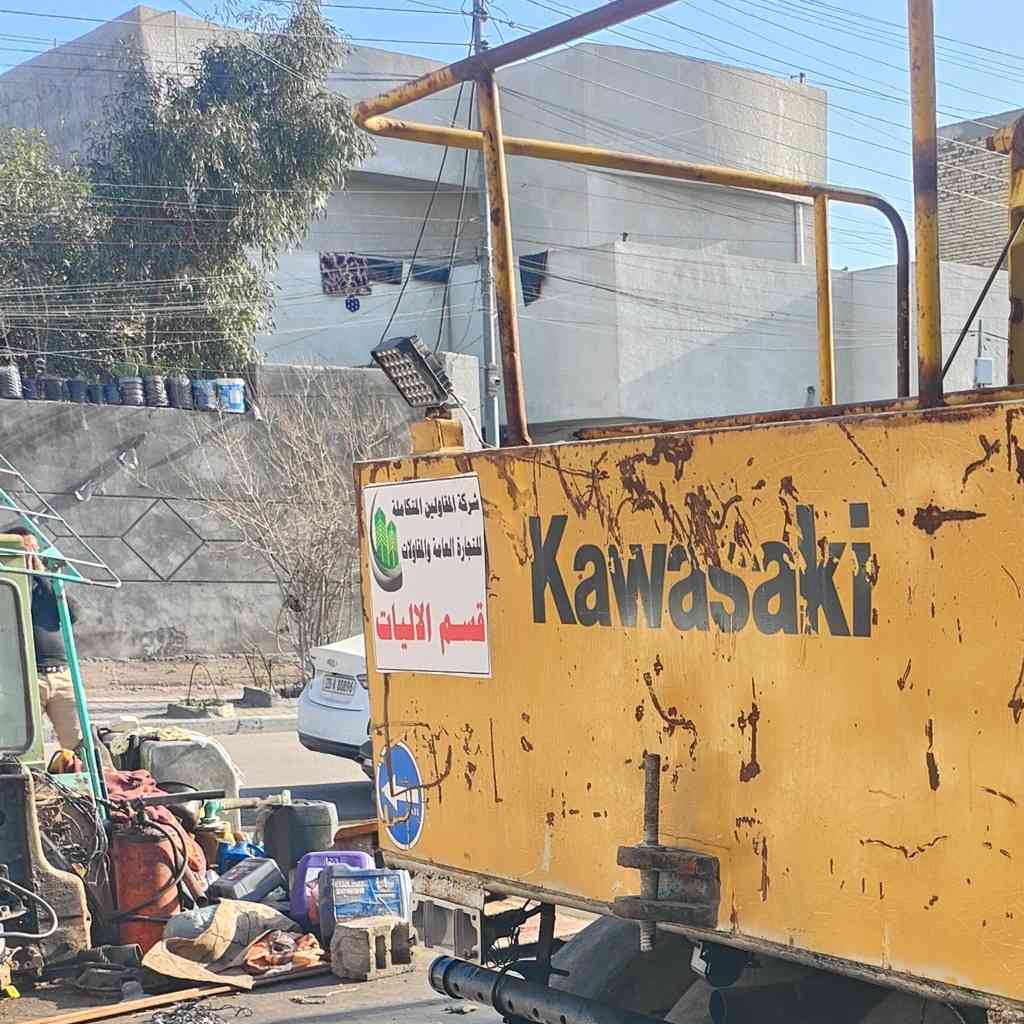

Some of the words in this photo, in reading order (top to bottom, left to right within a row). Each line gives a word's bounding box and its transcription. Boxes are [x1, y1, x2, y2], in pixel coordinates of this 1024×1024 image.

[424, 495, 457, 520] المقاولين
[458, 491, 481, 516] شركة
[432, 536, 455, 560] العامة
[457, 535, 482, 562] للتجارة
[528, 502, 872, 638] Kawasaki
[439, 602, 486, 656] قسم
